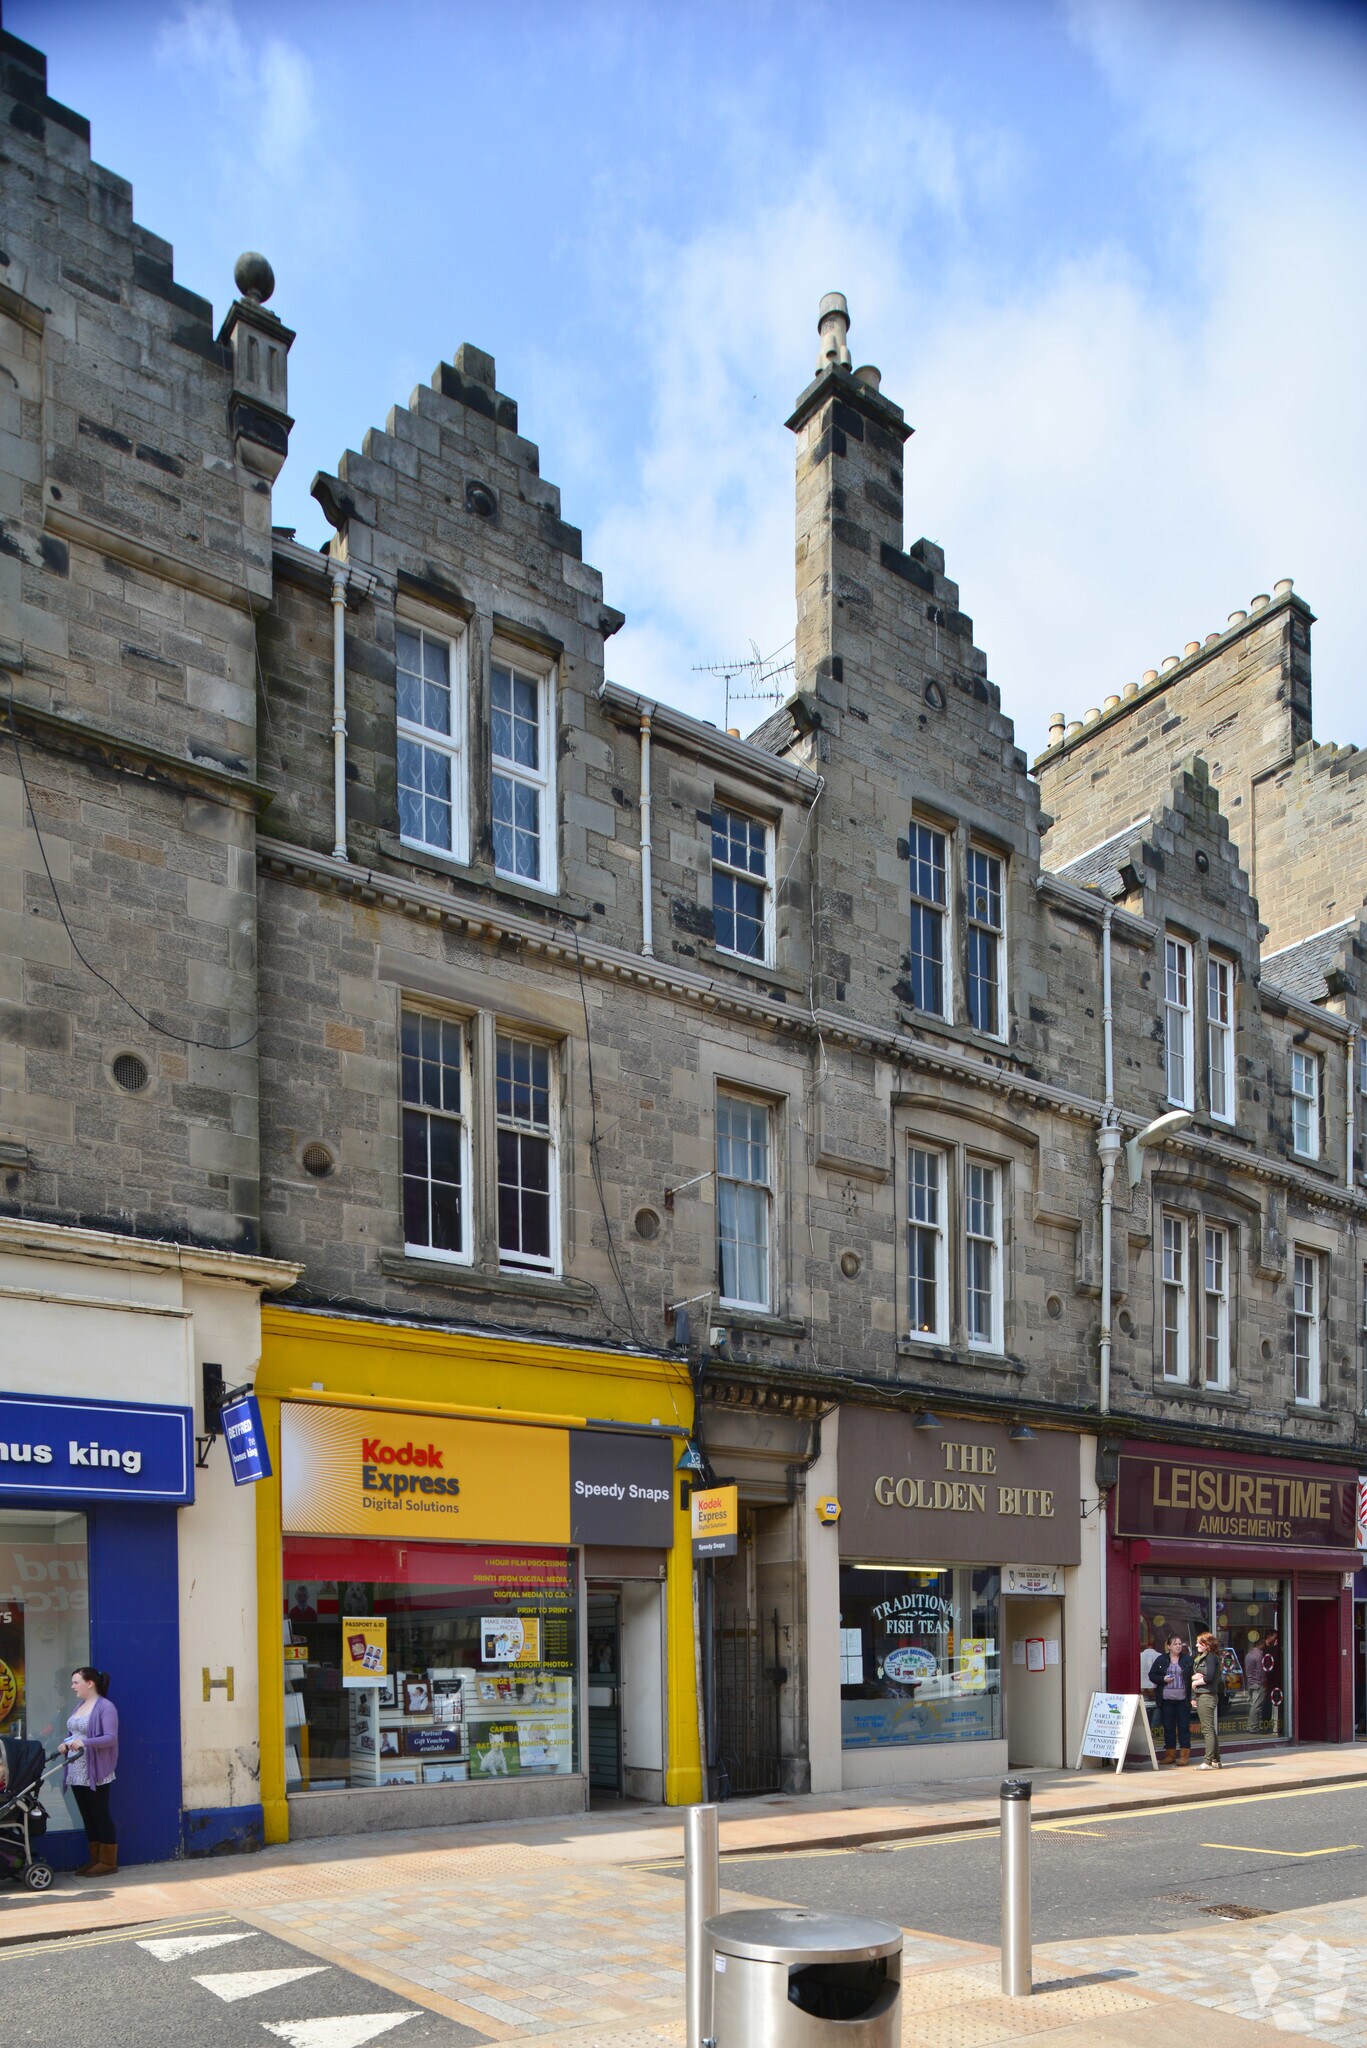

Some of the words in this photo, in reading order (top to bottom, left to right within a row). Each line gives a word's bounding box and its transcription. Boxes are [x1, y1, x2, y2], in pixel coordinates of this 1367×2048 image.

[69, 1441, 141, 1473] king
[362, 1438, 443, 1468] Kodak
[941, 1441, 997, 1475] THE
[362, 1465, 460, 1498] Express
[575, 1480, 625, 1500] Speedy
[629, 1484, 670, 1502] Snaps
[874, 1475, 987, 1513] GOLDEN
[997, 1486, 1055, 1518] BITE
[1153, 1466, 1331, 1520] LEISURETIME
[363, 1497, 402, 1511] Digital
[406, 1500, 459, 1513] Solutions
[698, 1498, 722, 1511] Kodak
[698, 1510, 727, 1523] Express
[1198, 1515, 1292, 1539] AMUSEMENTS
[546, 1575, 567, 1583] MEDIA
[872, 1593, 962, 1622] TRADITIONAL
[886, 1619, 914, 1634] FISH
[918, 1620, 950, 1634] TEAS
[490, 1725, 521, 1733] CAMERAS
[1219, 1722, 1237, 1732] FREE
[426, 1737, 450, 1745] Vouchers
